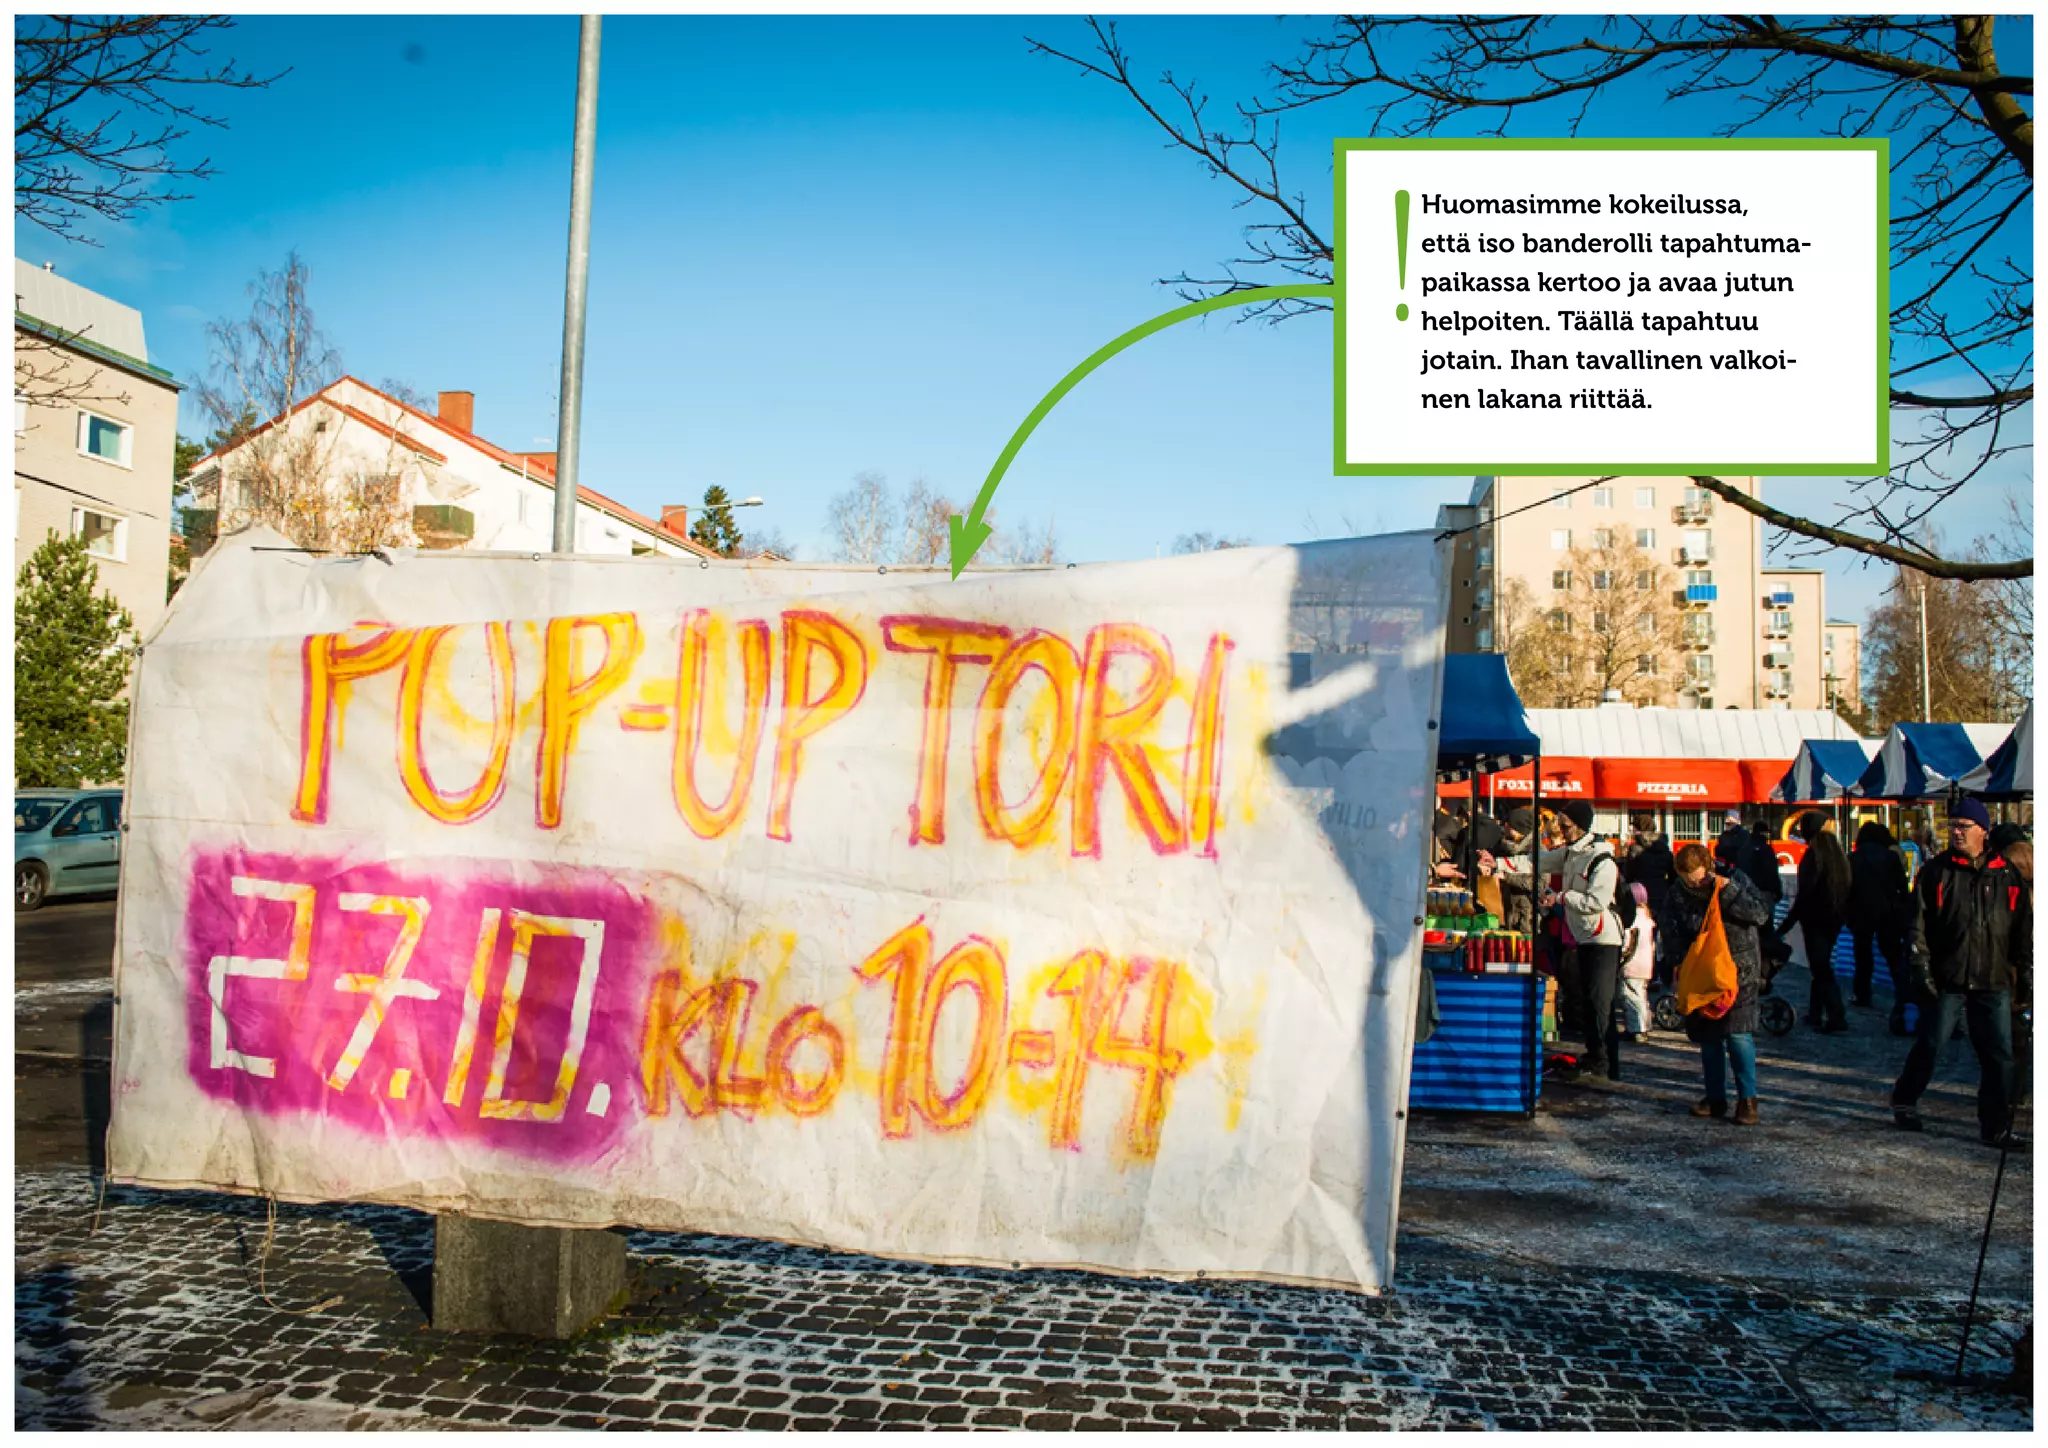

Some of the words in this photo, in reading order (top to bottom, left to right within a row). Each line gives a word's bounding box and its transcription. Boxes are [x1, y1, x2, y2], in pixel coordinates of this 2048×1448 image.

[290, 608, 868, 840] POP-UP
[878, 613, 1235, 861] TORI
[1637, 782, 1708, 795] PIZZERIA
[208, 876, 612, 1123] 27.10.
[850, 913, 1187, 1173] 10-14
